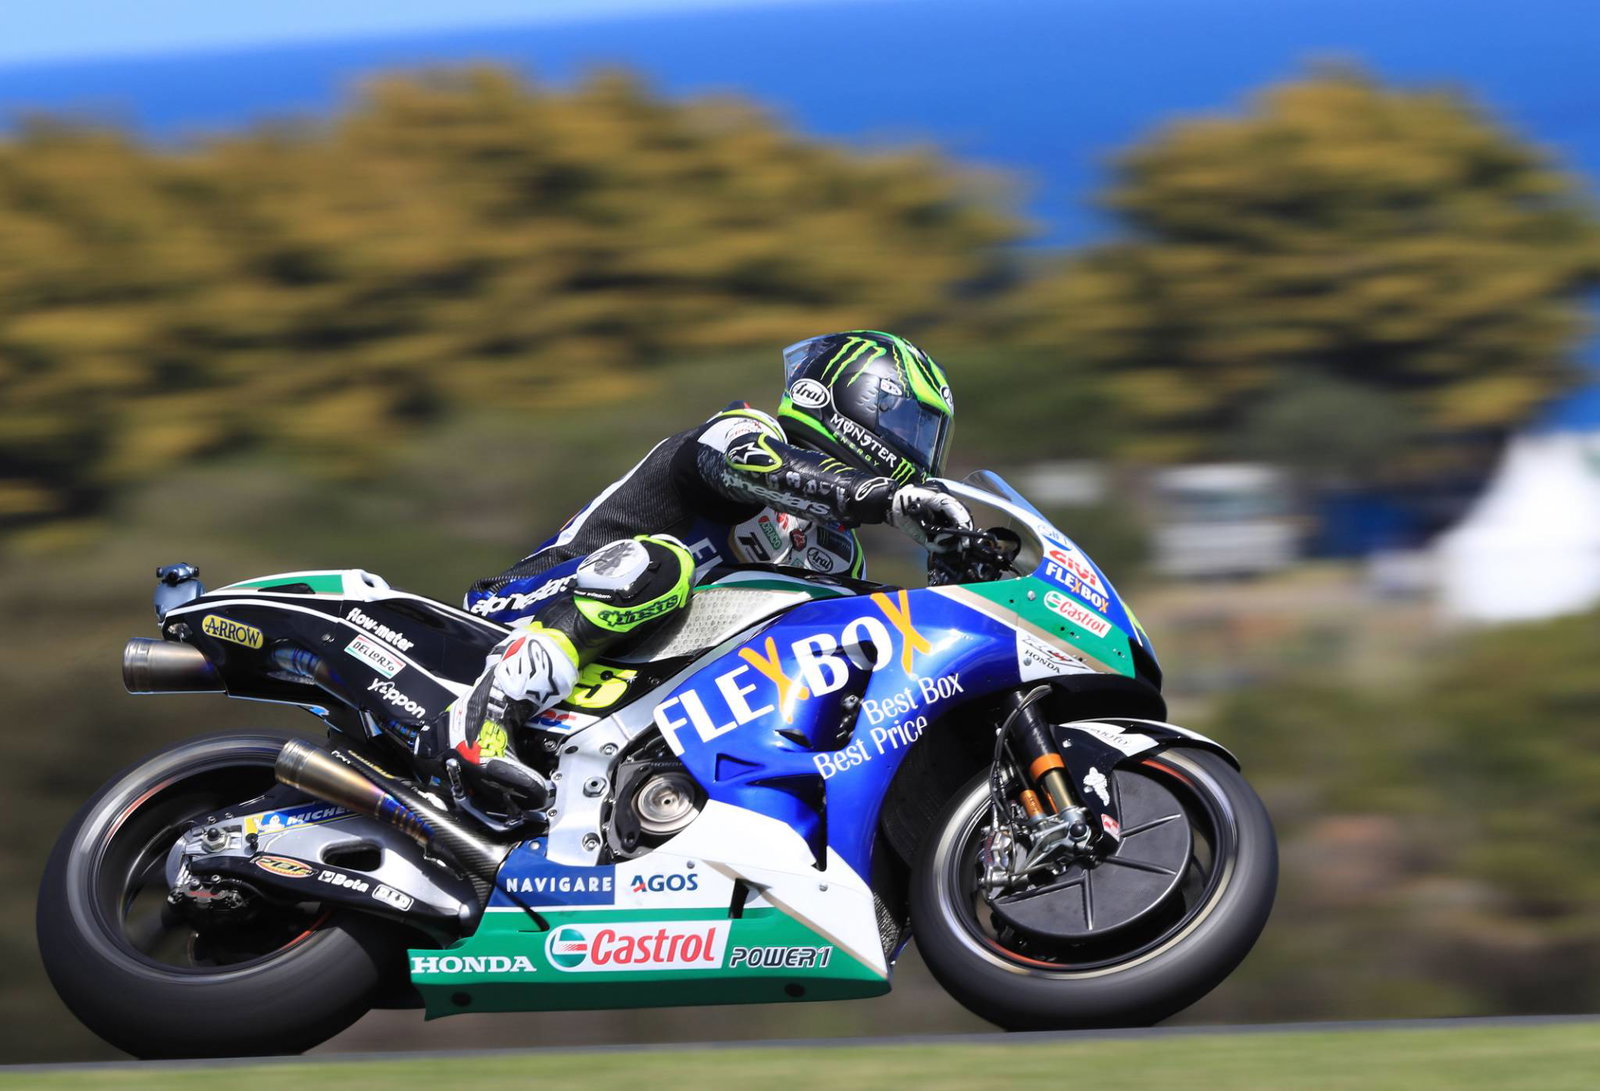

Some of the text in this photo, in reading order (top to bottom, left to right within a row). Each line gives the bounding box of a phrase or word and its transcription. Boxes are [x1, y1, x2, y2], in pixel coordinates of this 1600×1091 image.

[830, 413, 897, 468] MONSTER
[832, 431, 880, 467] ENERGY
[722, 471, 831, 515] pinestars
[1045, 561, 1109, 613] FLEXBOX
[204, 617, 260, 647] ARROW
[345, 607, 414, 652] flow-meter
[1059, 601, 1108, 634] Castrol
[1025, 649, 1061, 674] HONDA
[863, 673, 964, 725] Best Box
[812, 715, 928, 780] Best Price
[286, 806, 351, 826] MICHE
[331, 873, 370, 893] Beta
[506, 876, 612, 893] NAVIGARE
[631, 873, 698, 893] AGOS
[591, 926, 716, 966] Castrol
[729, 946, 832, 969] POWER1
[410, 956, 536, 974] HONDA
